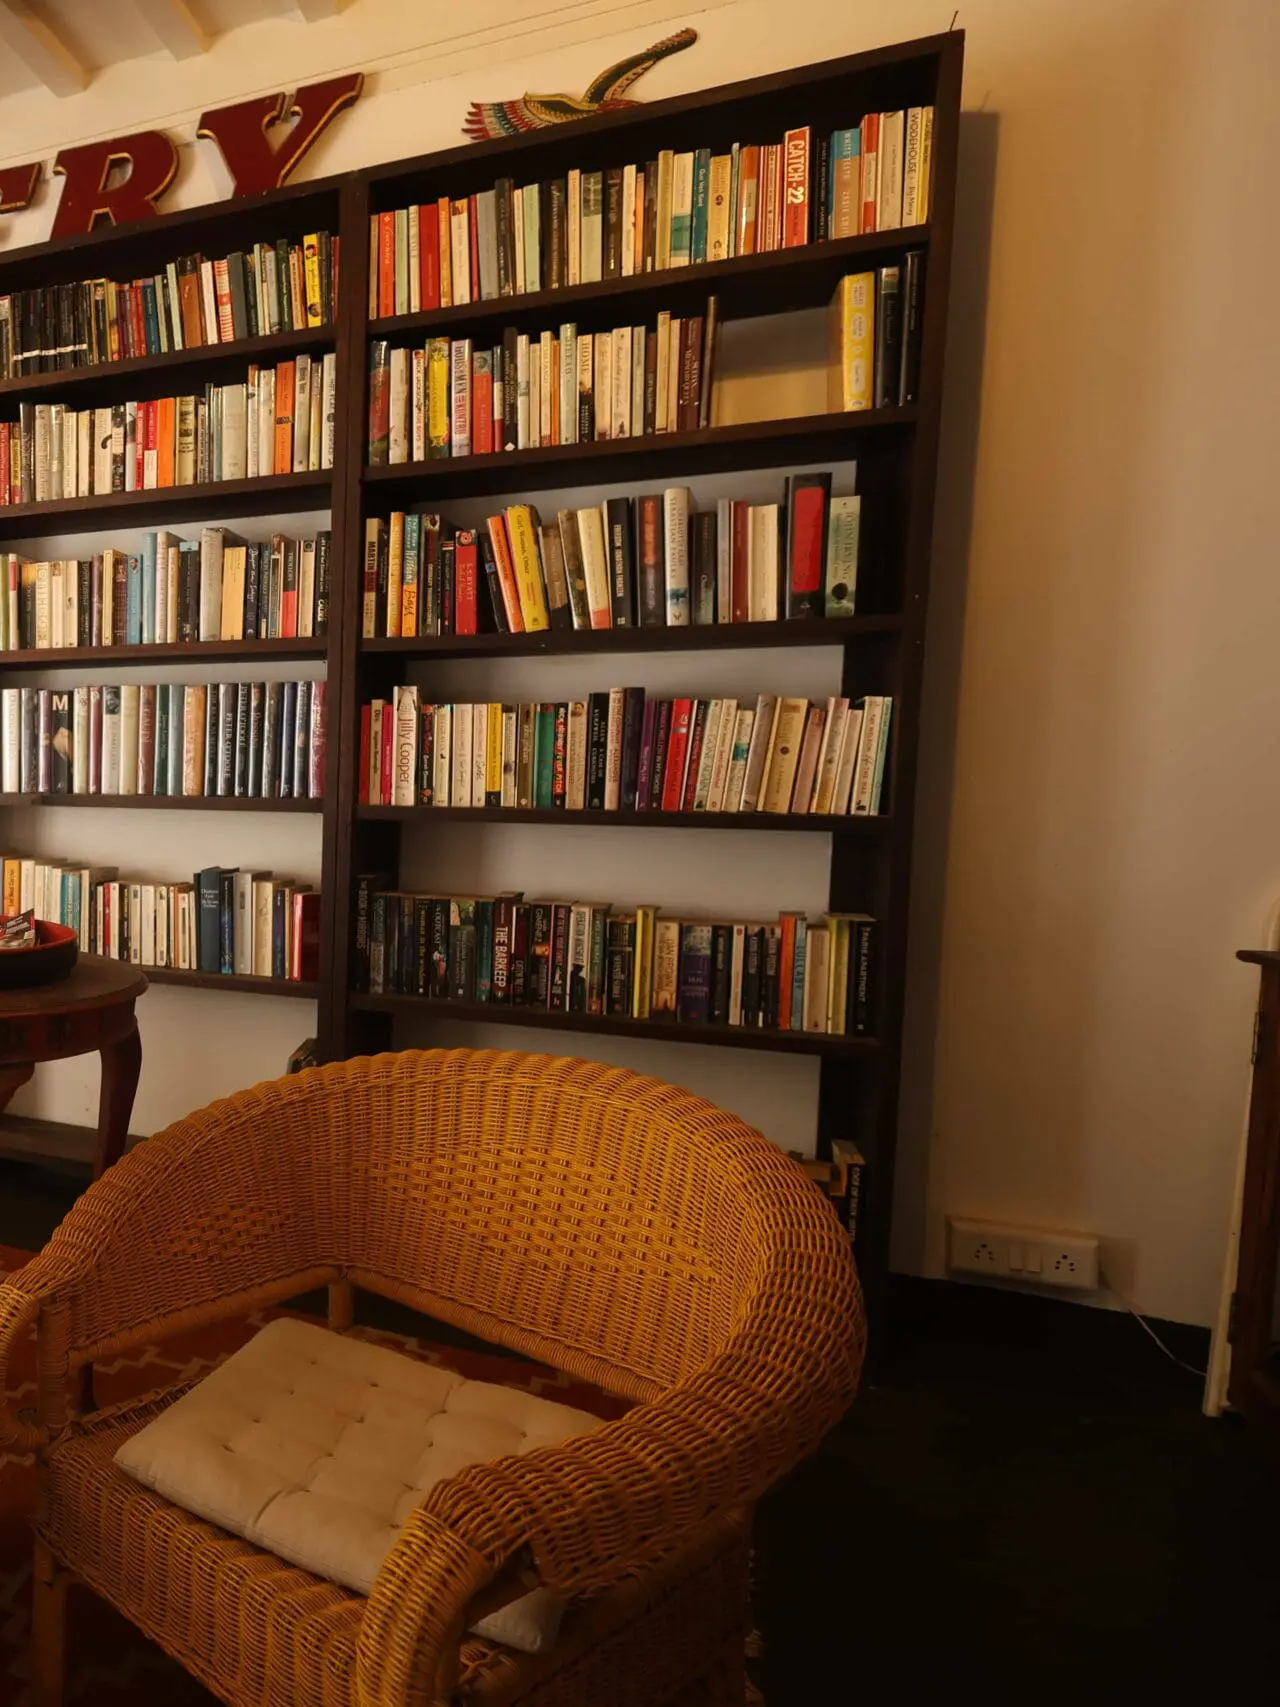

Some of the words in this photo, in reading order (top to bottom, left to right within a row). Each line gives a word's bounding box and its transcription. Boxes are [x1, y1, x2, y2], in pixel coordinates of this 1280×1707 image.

[907, 113, 919, 175] WODEHOUSE
[787, 139, 807, 205] CATCH-22
[581, 342, 589, 375] HOME
[844, 512, 854, 540] JOHN
[367, 541, 376, 571] MARTIN
[842, 542, 854, 580] IRVING
[52, 694, 68, 711] M
[240, 686, 248, 713] PETER
[225, 712, 233, 740] PETER
[239, 713, 248, 748] O'TOOLE
[399, 718, 415, 740] Jilly
[223, 741, 233, 779] O'TOOLE
[397, 743, 414, 784] Cooper
[555, 772, 564, 794] PITCH
[496, 926, 508, 944] THE
[494, 945, 508, 988] BARKEEP
[858, 955, 869, 1003] APARTMENT
